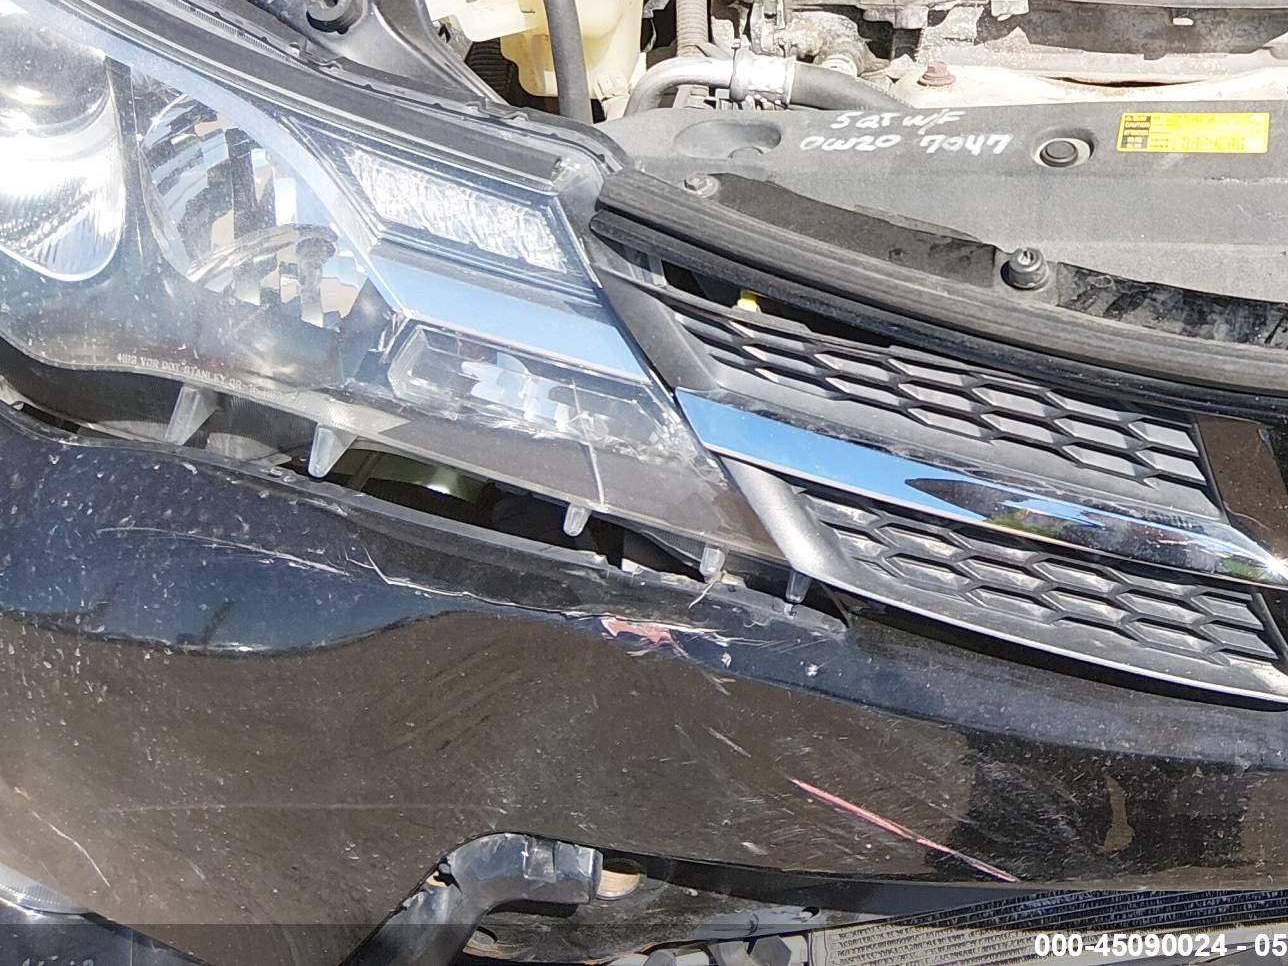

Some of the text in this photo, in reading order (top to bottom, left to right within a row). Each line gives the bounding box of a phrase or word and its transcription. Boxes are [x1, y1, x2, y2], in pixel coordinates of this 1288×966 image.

[919, 134, 1014, 156] 7047
[161, 359, 182, 372] DOT
[183, 363, 227, 385] STANLEY
